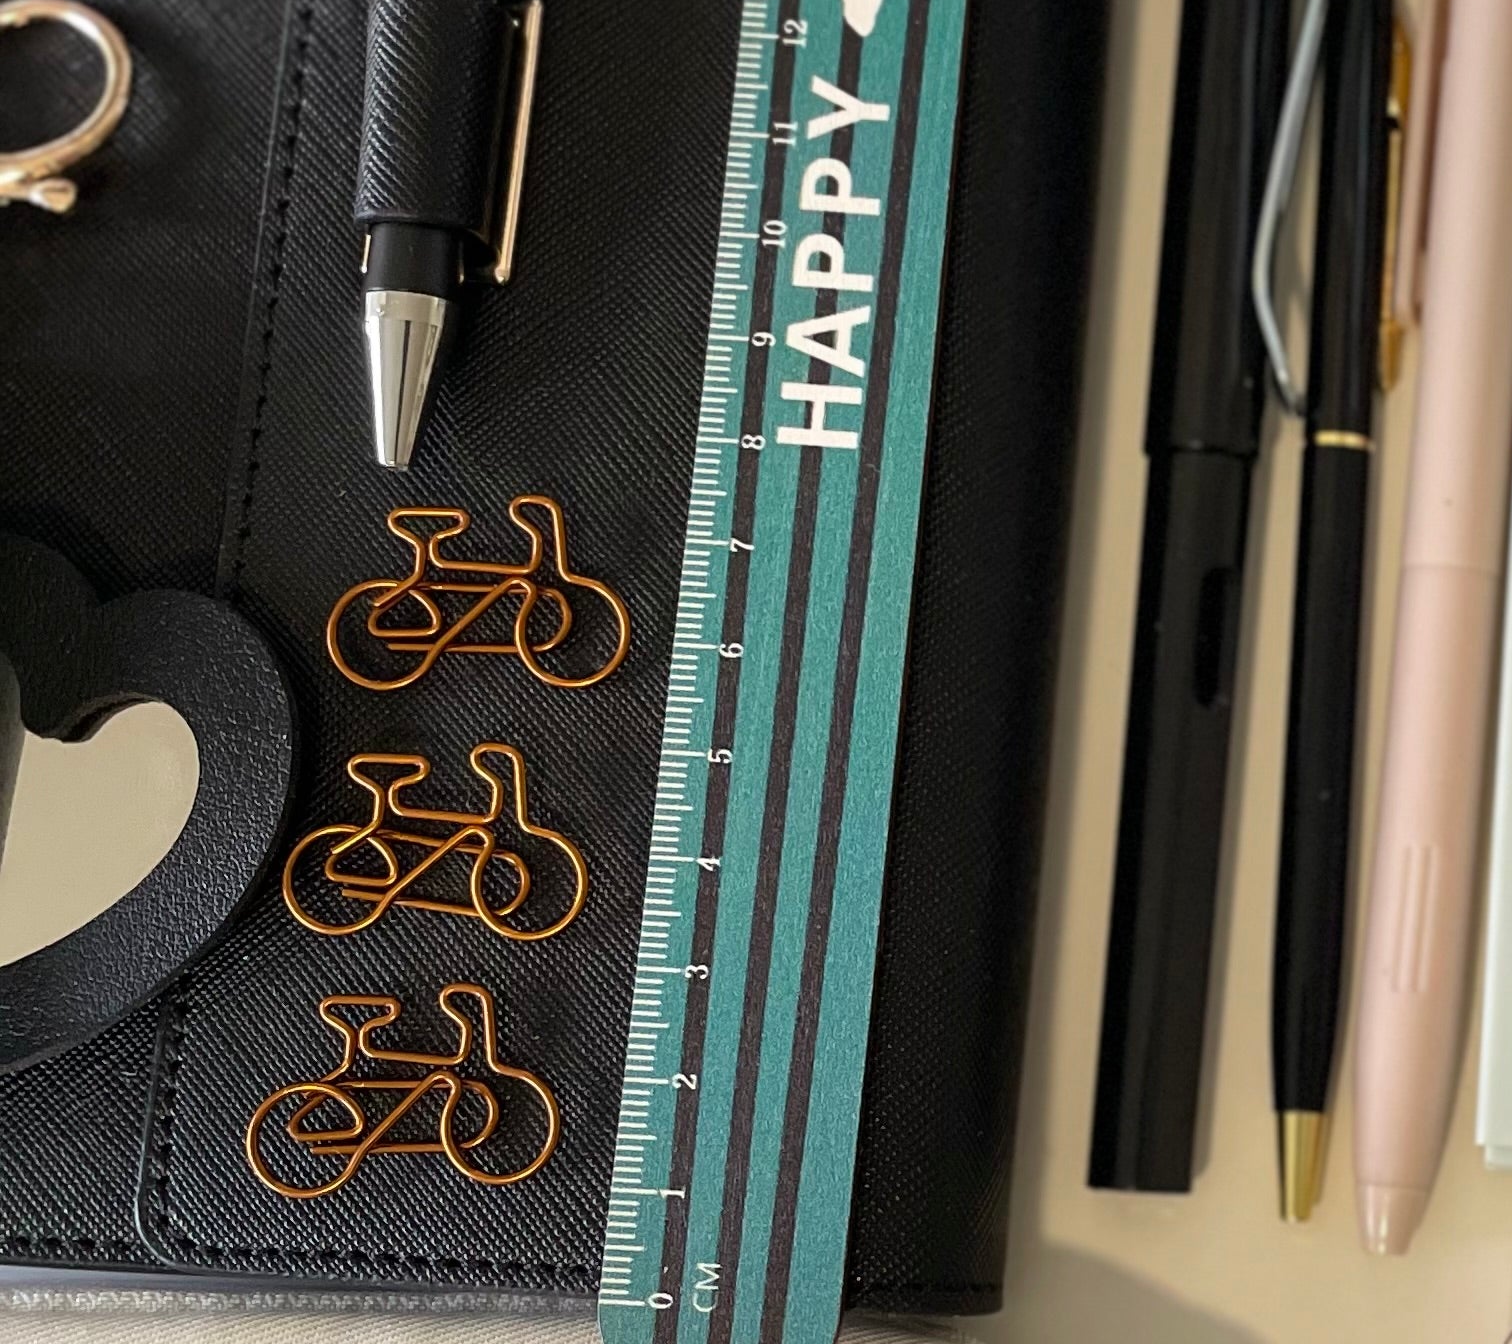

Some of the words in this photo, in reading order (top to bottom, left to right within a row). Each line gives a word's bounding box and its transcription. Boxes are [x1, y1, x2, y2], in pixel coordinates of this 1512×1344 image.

[783, 18, 809, 48] 12
[772, 121, 799, 148] 11
[761, 219, 788, 250] 10
[775, 75, 891, 450] HAPPY
[751, 330, 777, 347] 9
[740, 433, 767, 451] 8
[729, 537, 756, 553] 7
[719, 642, 745, 659] 6
[707, 747, 733, 765] 5
[696, 855, 722, 872] 4
[684, 963, 710, 981] 3
[672, 1072, 698, 1091] 2
[658, 1186, 687, 1200] 1
[692, 1261, 722, 1314] CM
[648, 1291, 674, 1310] 0
